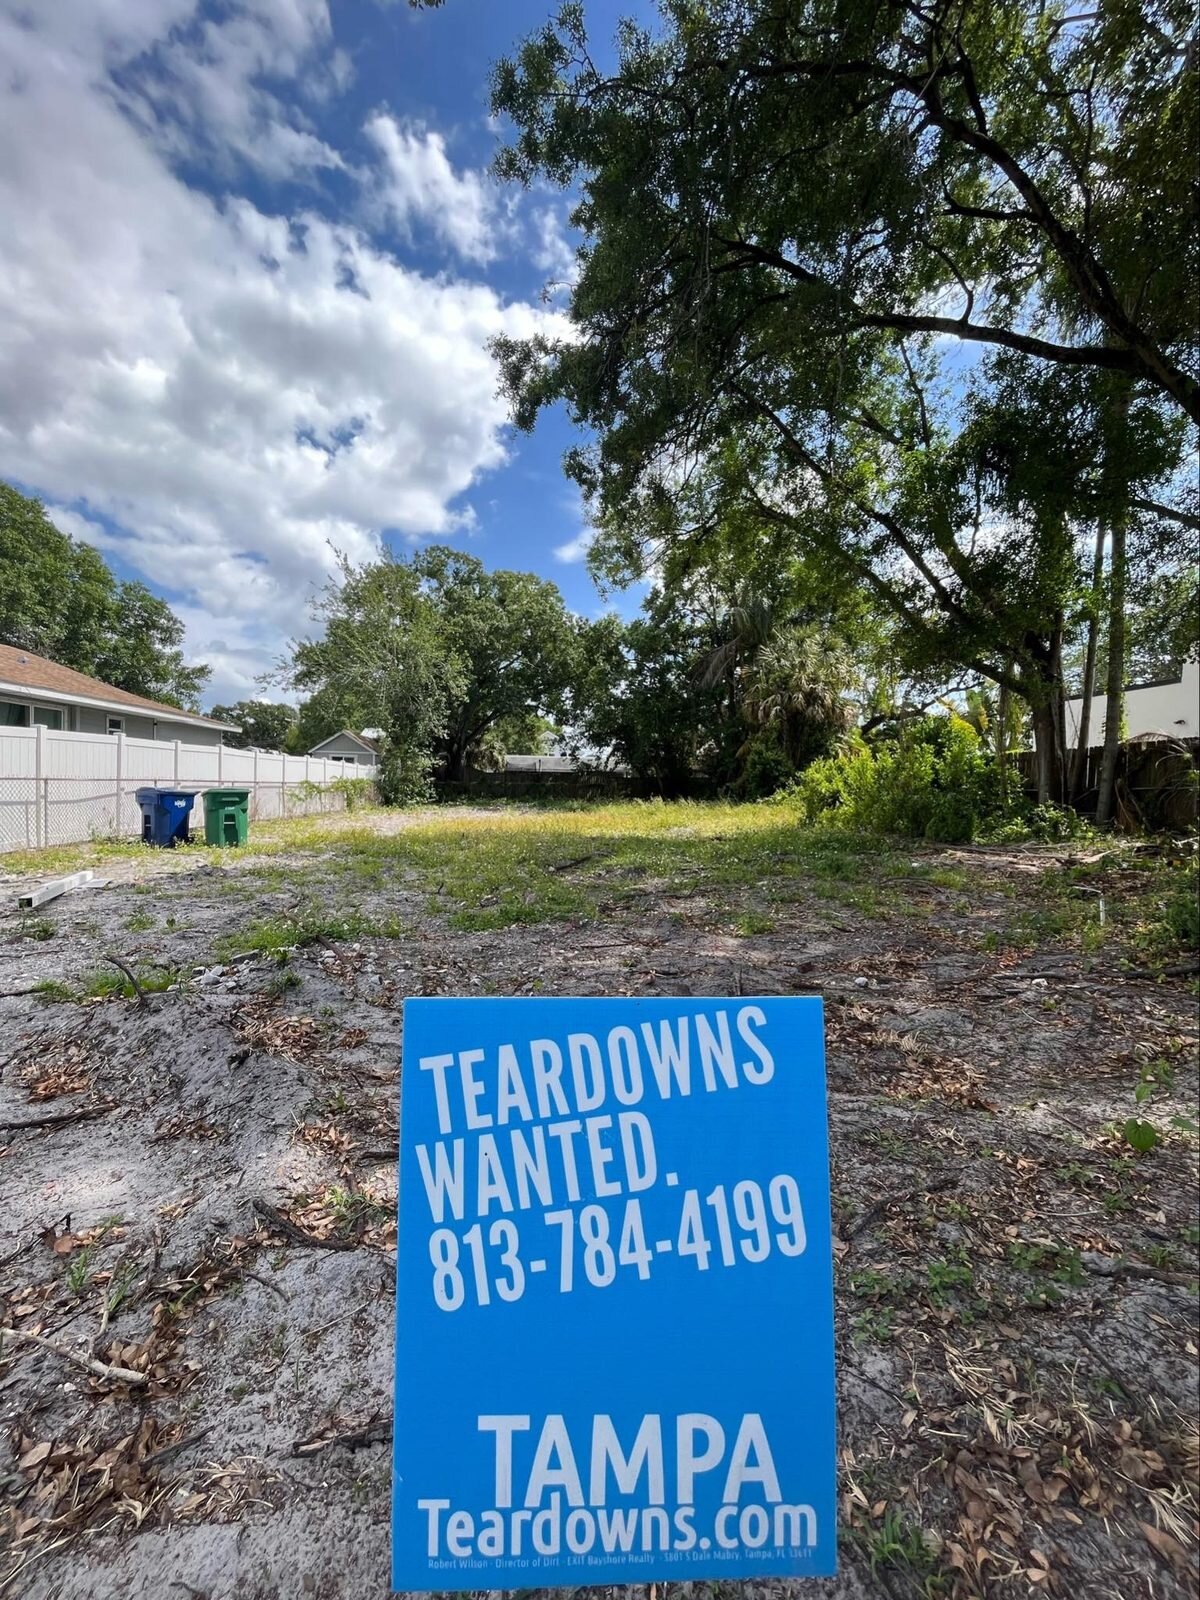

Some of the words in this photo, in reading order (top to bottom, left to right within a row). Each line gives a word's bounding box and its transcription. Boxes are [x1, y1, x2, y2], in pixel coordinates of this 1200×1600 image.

[419, 1005, 775, 1134] TEARDOWNS
[415, 1111, 679, 1223] WANTED.
[429, 1174, 807, 1312] 813-784-4199
[477, 1413, 782, 1508] TAMPA
[417, 1491, 817, 1557] Teardowns.com
[428, 1558, 456, 1569] Robert
[459, 1558, 488, 1569] Wilson
[495, 1558, 529, 1568] Director
[532, 1557, 541, 1567] of
[588, 1554, 626, 1566] Bayshore
[628, 1553, 655, 1564] Realty
[692, 1551, 711, 1561] Dale
[776, 1548, 785, 1559] FL
